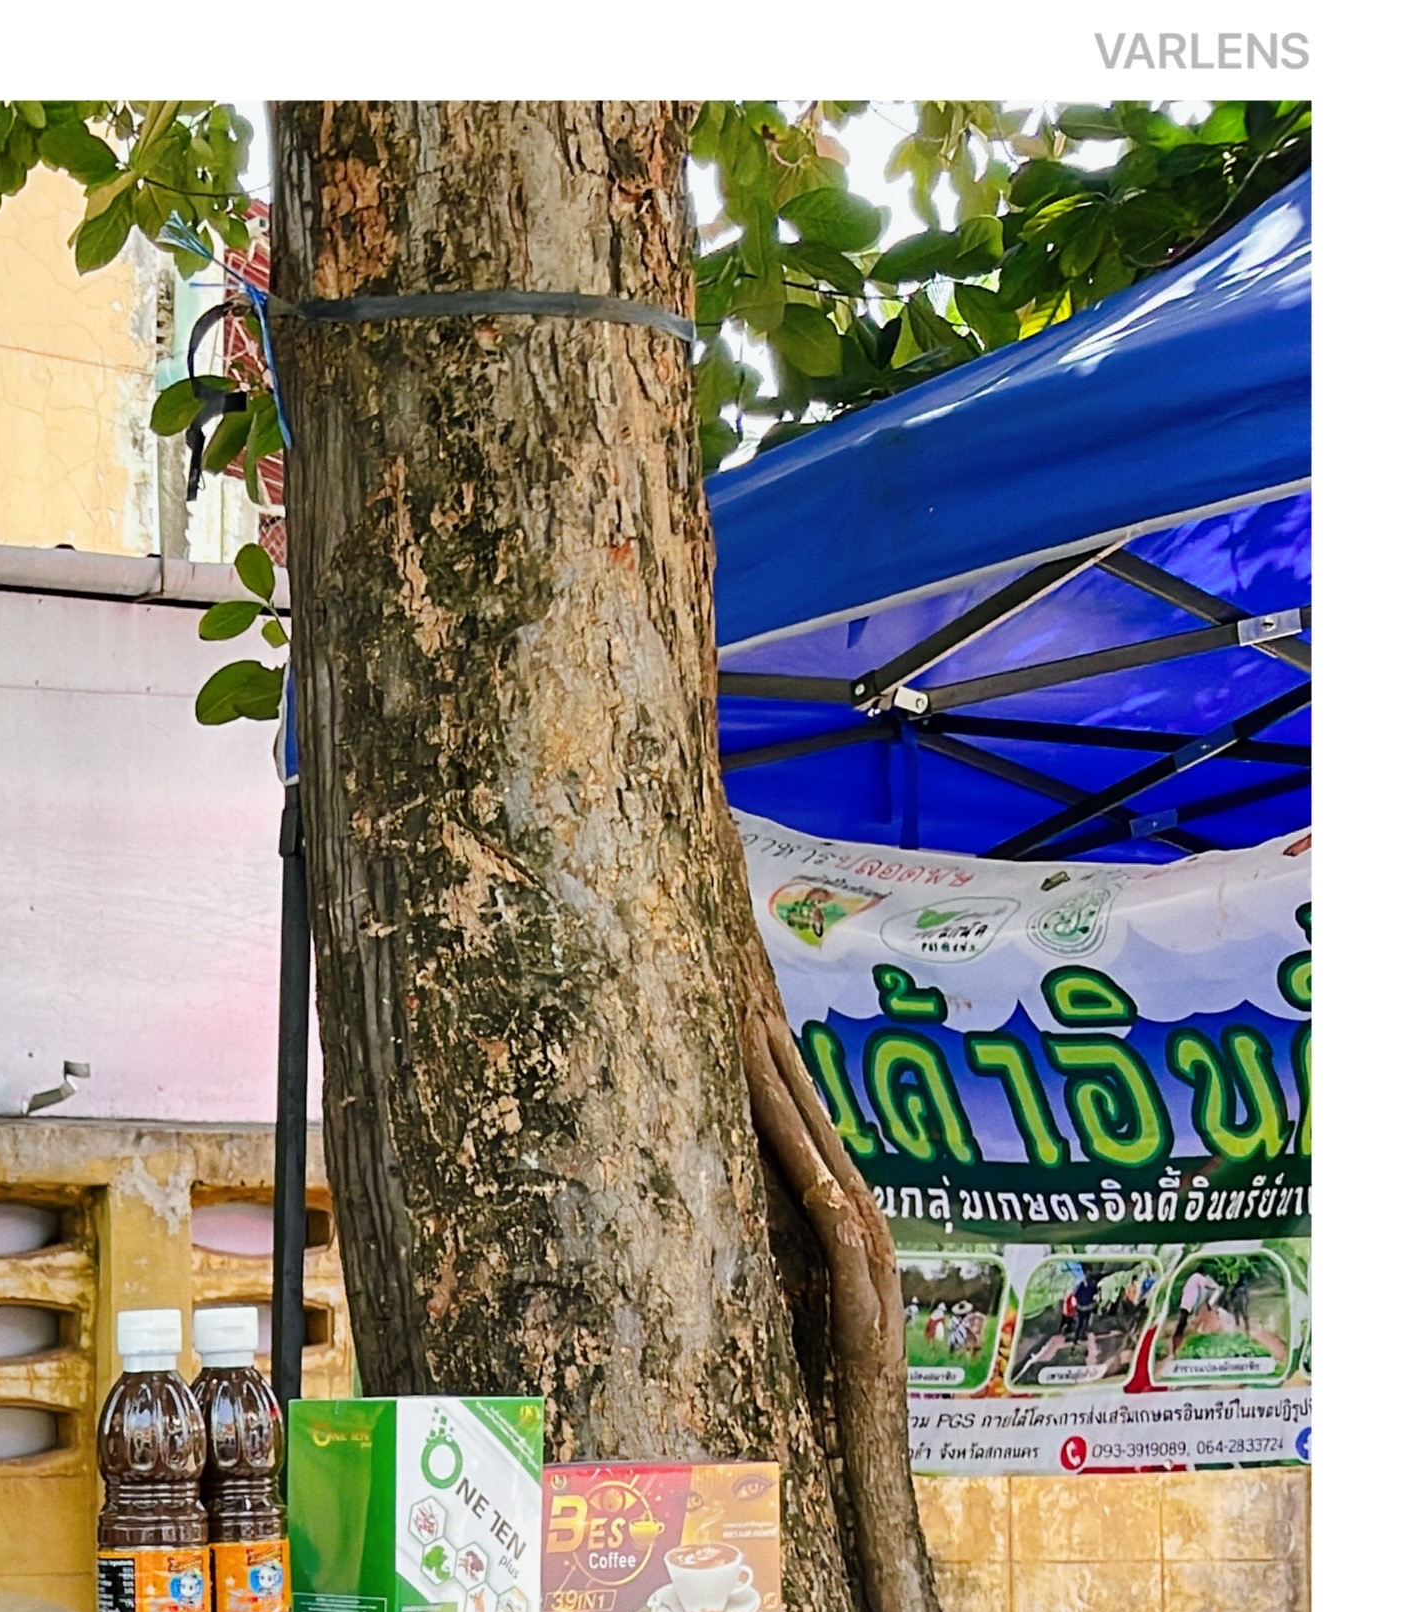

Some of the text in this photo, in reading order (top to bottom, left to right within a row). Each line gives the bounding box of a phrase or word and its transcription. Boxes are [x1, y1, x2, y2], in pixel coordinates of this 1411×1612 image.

[937, 1413, 976, 1429] PGS
[499, 1554, 521, 1581] plus
[587, 1552, 637, 1571] Coffee
